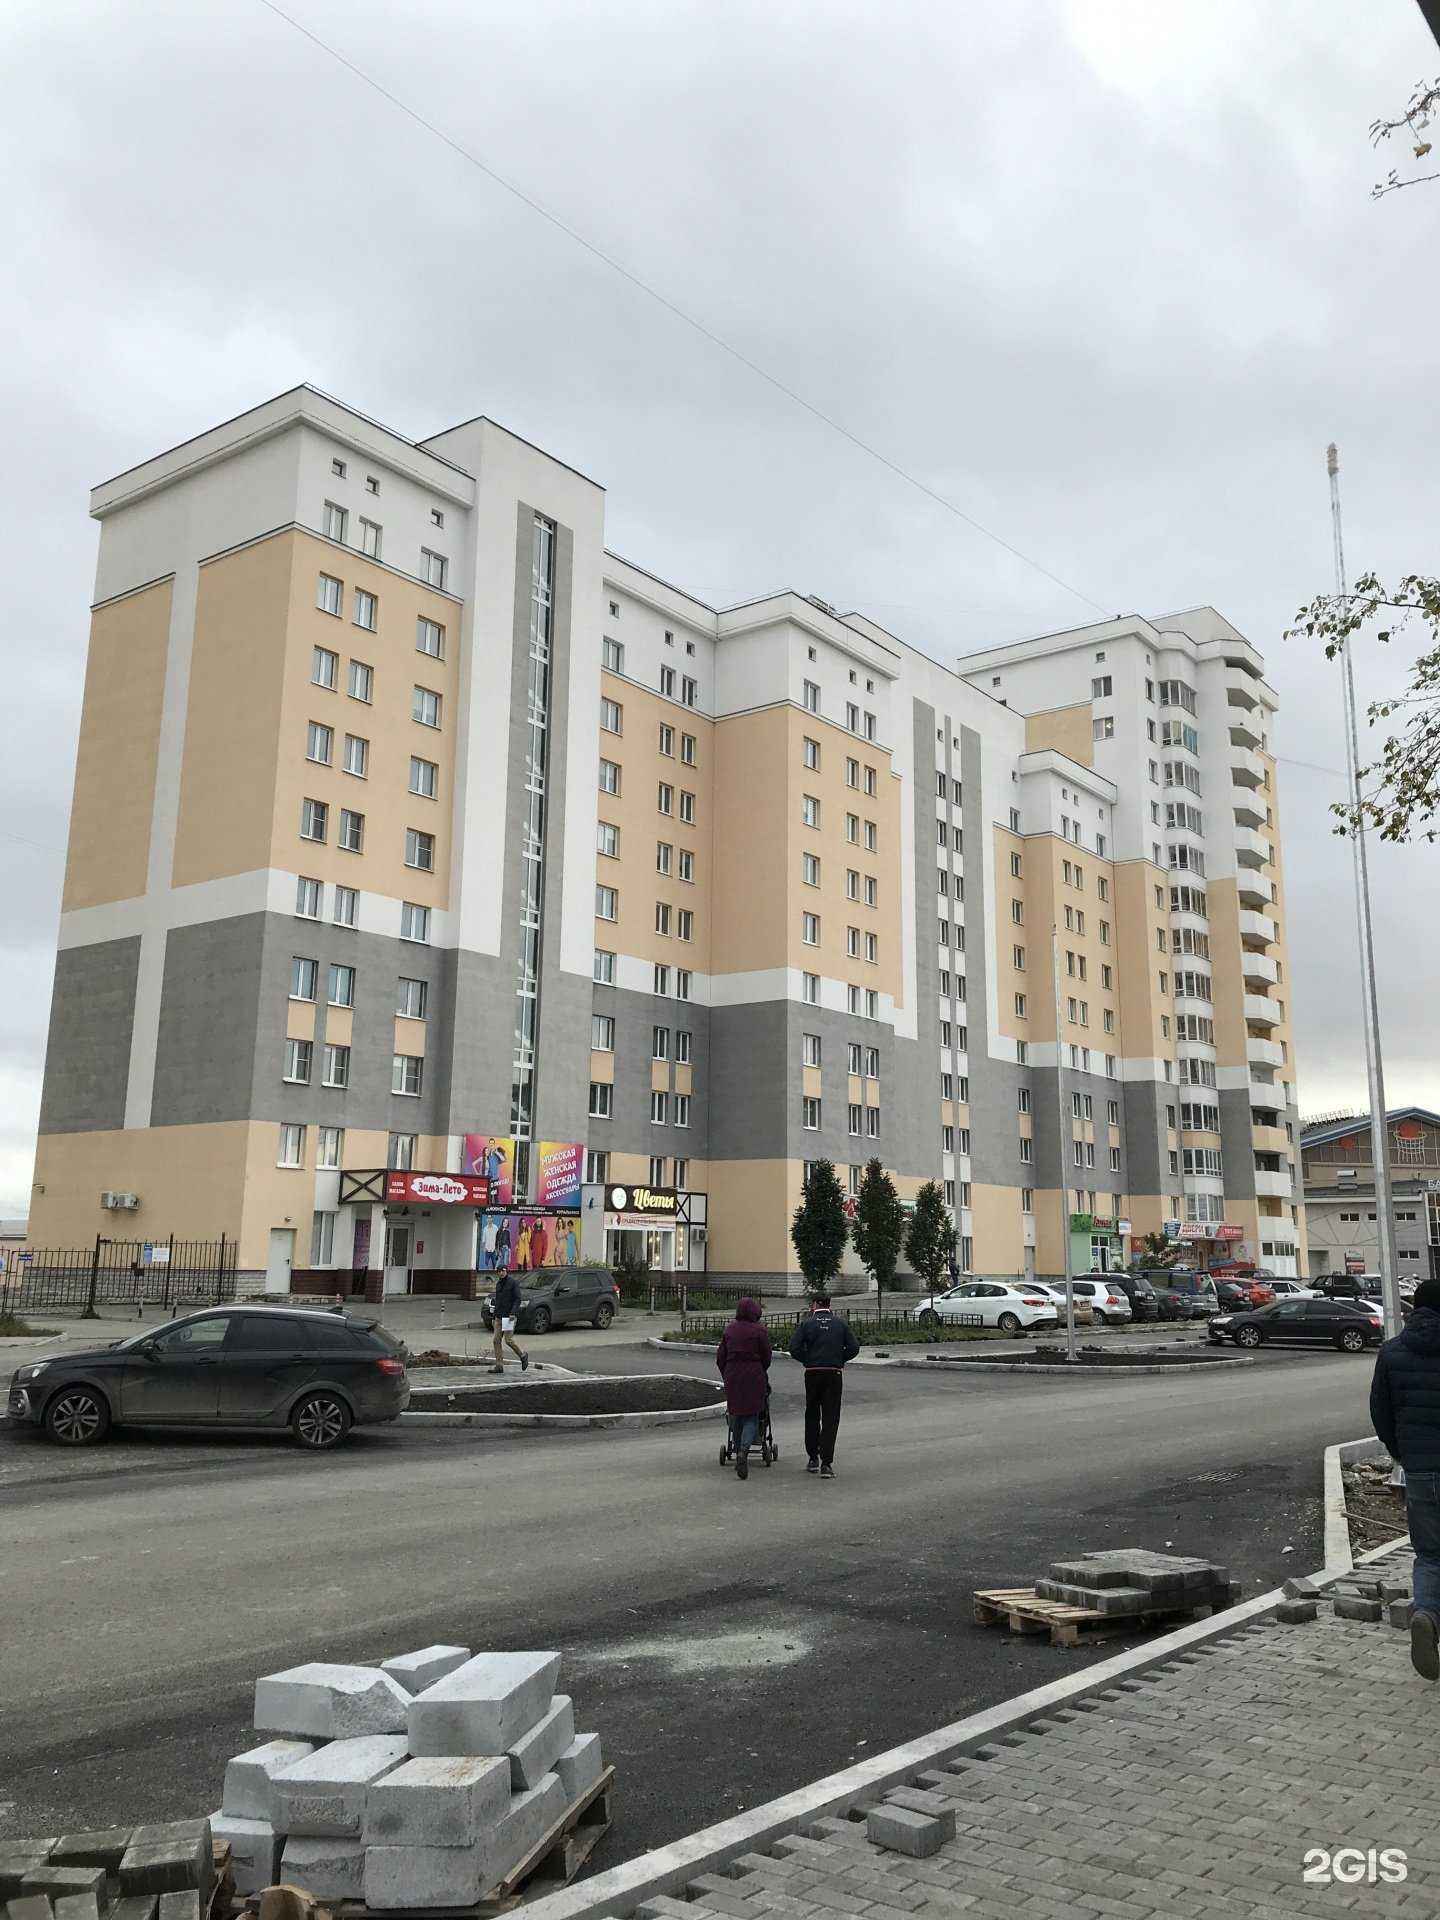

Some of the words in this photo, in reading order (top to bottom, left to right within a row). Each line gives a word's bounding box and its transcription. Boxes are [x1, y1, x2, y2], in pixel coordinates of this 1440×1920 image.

[543, 1147, 576, 1164] МУЖСКАЯ
[543, 1160, 577, 1177] ЖЕНСКАЯ
[418, 1181, 462, 1195] Зима-Лето
[546, 1172, 577, 1190] ОДЕЖДА
[545, 1183, 580, 1201] АКСЕССУАРЫ
[632, 1188, 675, 1210] Цветы
